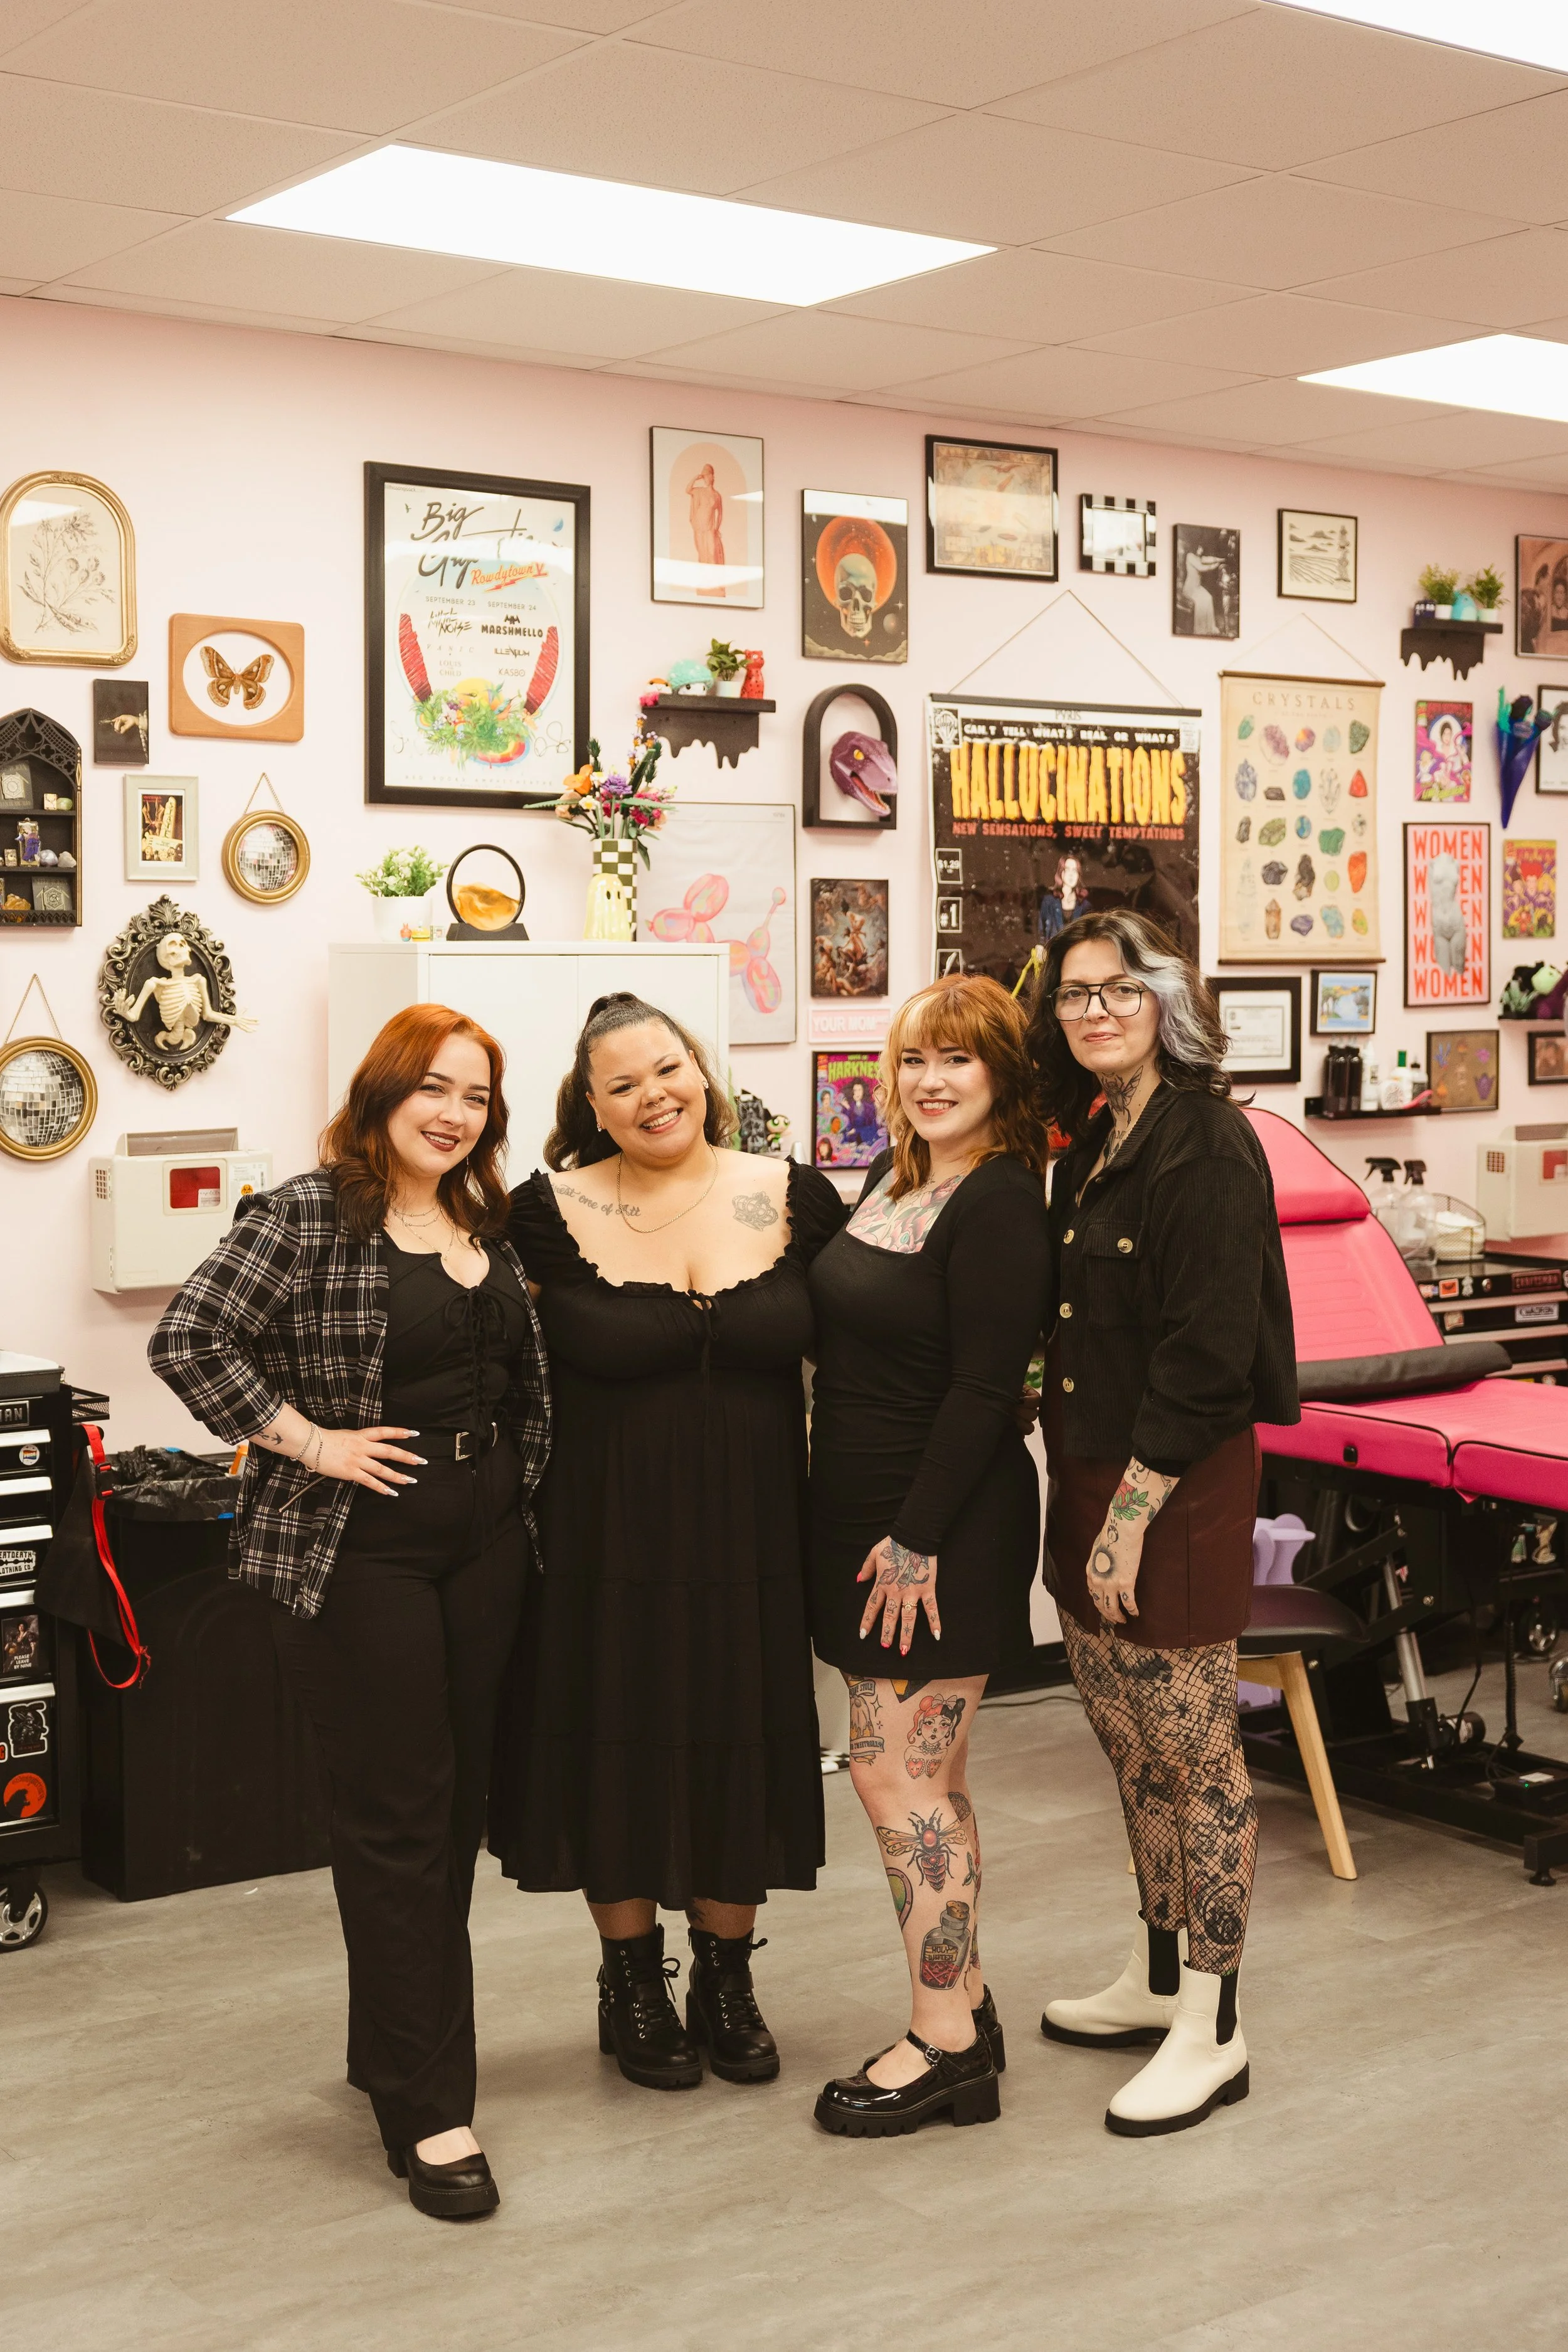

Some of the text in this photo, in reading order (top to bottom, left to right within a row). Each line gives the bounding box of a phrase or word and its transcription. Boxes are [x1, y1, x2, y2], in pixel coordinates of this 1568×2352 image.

[410, 501, 484, 541] Big
[471, 564, 534, 585] Rowdytown
[425, 596, 464, 605] SEPTEMBER
[487, 601, 526, 610] SEPTEMBER
[481, 624, 544, 638] MARSHMELLO
[439, 668, 462, 677] CHILD
[498, 668, 526, 677] KASBO
[1253, 691, 1355, 711] CRYSTALS
[1002, 726, 1027, 737] TELL
[1079, 729, 1108, 741] REAL
[1113, 731, 1129, 742] OR
[950, 740, 1187, 826] HALLUCINATIONS
[952, 822, 1185, 841] NEW SENSATIONS, SWEET TEMPTATIONS
[1414, 830, 1483, 860] WOMEN
[1414, 864, 1483, 895] WEN
[940, 903, 957, 928] #1
[1414, 967, 1483, 999] WOMEN
[813, 1016, 846, 1033] YOUR
[849, 1016, 875, 1032] MOM
[578, 1195, 598, 1209] one
[601, 1203, 613, 1216] of
[932, 1946, 948, 1954] HOLY
